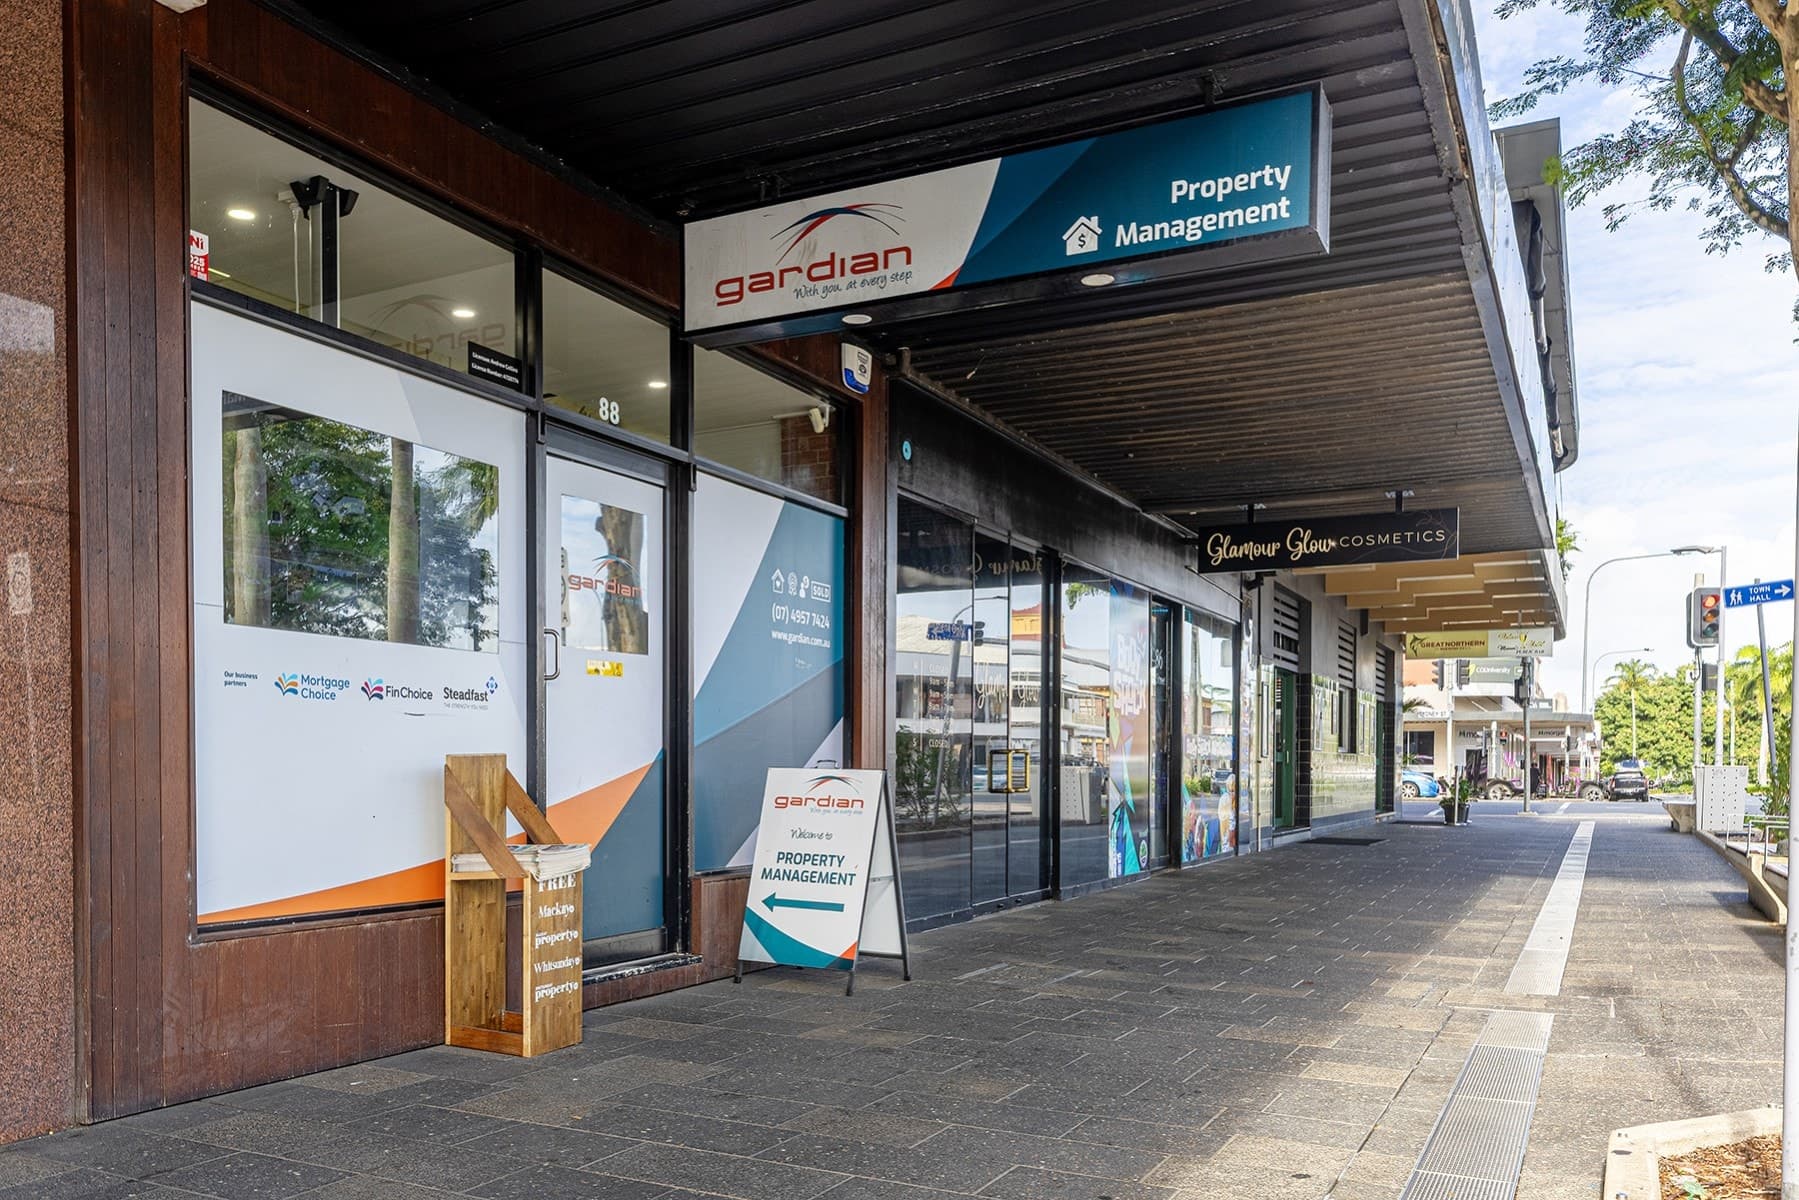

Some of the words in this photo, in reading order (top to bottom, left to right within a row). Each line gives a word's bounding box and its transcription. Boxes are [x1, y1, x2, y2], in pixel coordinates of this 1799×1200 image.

[1171, 164, 1292, 204] Property
[1115, 196, 1291, 247] Management
[715, 245, 912, 307] gardian
[793, 283, 820, 299] With
[846, 279, 858, 291] at
[859, 275, 888, 290] every
[599, 397, 620, 425] 88
[1207, 532, 1281, 566] Glamour
[1286, 527, 1335, 561] Glow
[1339, 529, 1446, 548] COSMETICS
[813, 585, 830, 599] SOLD
[1749, 585, 1771, 594] TOWN
[1749, 594, 1771, 603] HALL
[772, 602, 790, 625] (07)
[790, 608, 810, 625] 4957
[811, 612, 830, 630] 7424
[771, 630, 831, 649] www.gardian.com.au
[223, 670, 235, 678] Our
[235, 671, 258, 680] business
[301, 674, 350, 690] Mortgage
[301, 688, 336, 701] Choice
[386, 685, 433, 700] FinChoice
[443, 686, 489, 702] Steadfast
[774, 794, 864, 809] gardian
[790, 827, 824, 840] Welcome
[824, 832, 833, 840] to
[776, 851, 846, 868] PROPERTY
[538, 873, 577, 893] FREE
[761, 867, 857, 886] MANAGEMENT
[539, 901, 570, 919] Mackay
[535, 928, 574, 949] property
[533, 956, 576, 974] Whitsunday
[535, 981, 574, 1003] property
